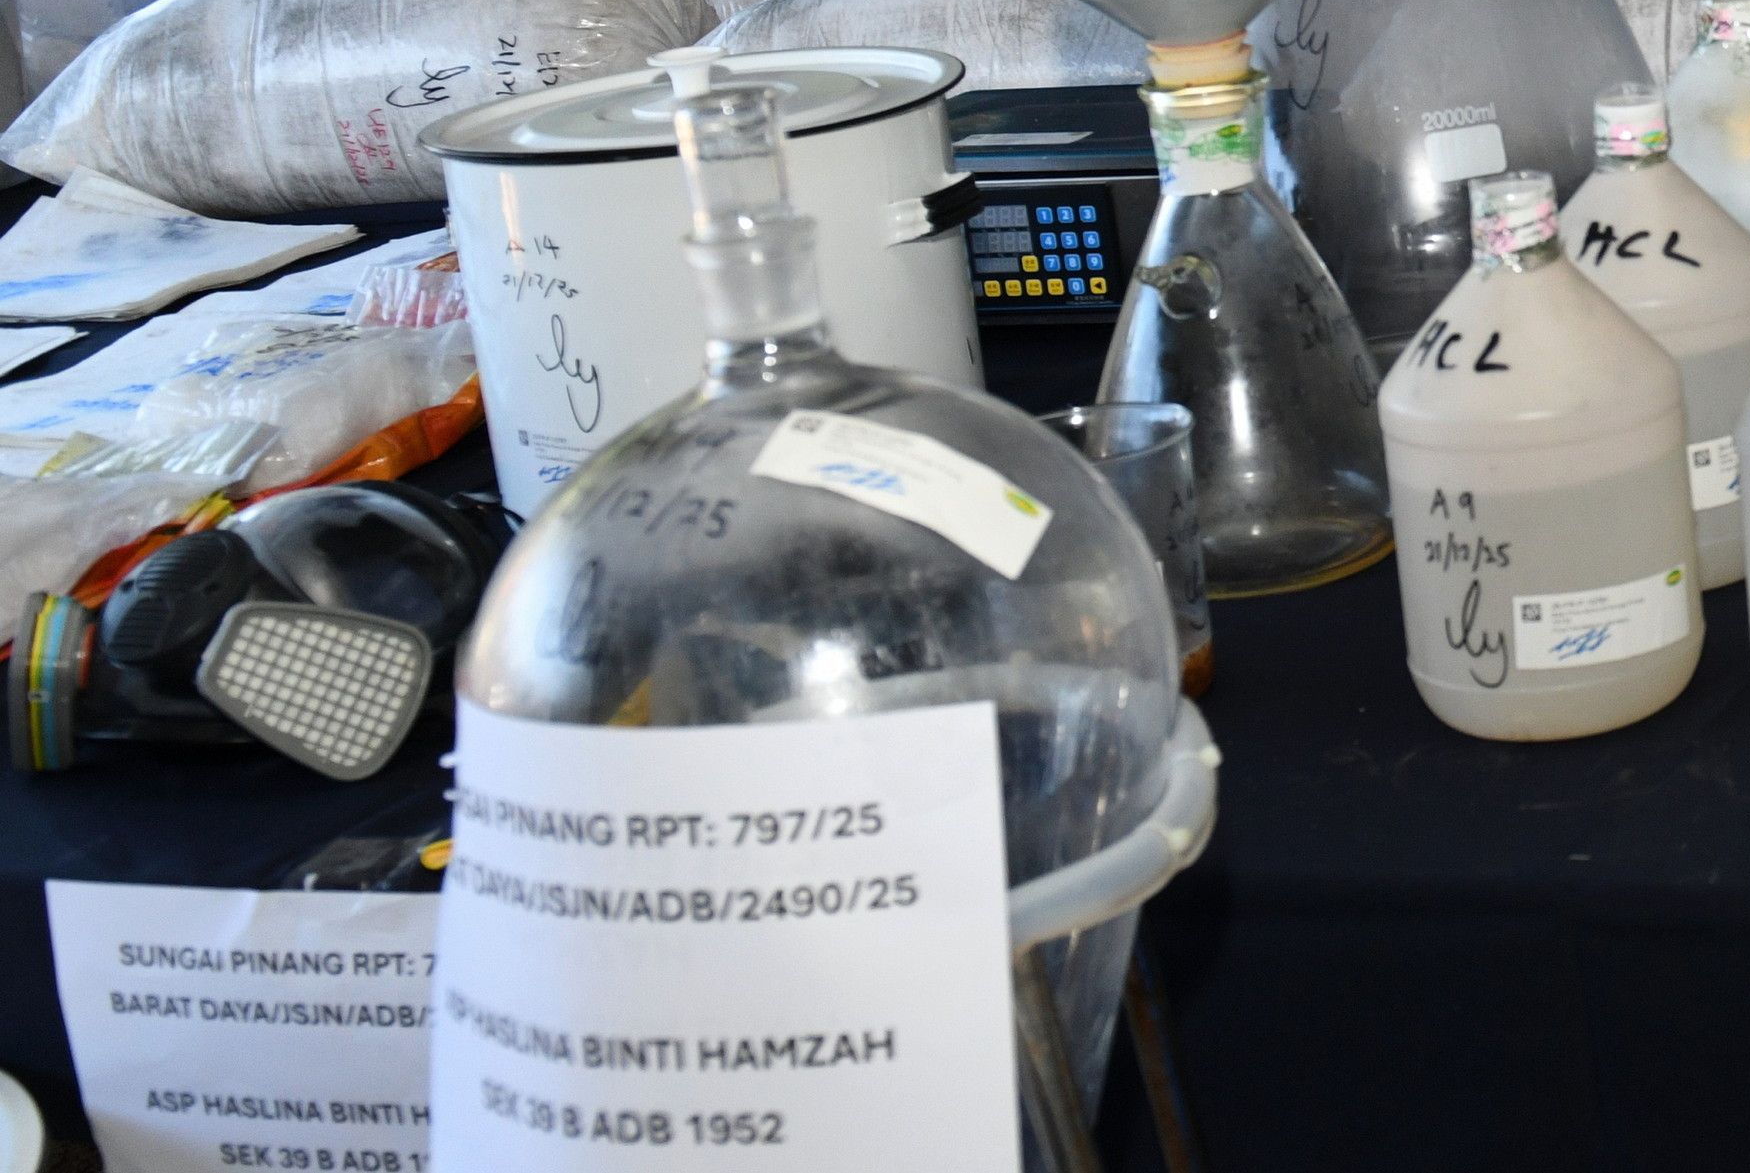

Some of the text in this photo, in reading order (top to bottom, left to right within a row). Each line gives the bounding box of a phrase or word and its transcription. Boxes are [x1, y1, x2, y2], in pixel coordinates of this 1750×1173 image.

[1421, 102, 1495, 130] 20000ml
[1041, 210, 1048, 220] 1
[1062, 210, 1071, 220] 2
[1084, 209, 1092, 219] 3
[1045, 235, 1096, 246] 4 5 6
[1578, 221, 1702, 268] HCL
[1047, 258, 1056, 268] 7
[1090, 257, 1099, 267] 9
[1072, 282, 1080, 291] 0
[1408, 320, 1511, 372] HCL
[627, 813, 718, 849] RPT:
[730, 801, 885, 847] 797/25
[118, 942, 224, 973] SUNGAI
[230, 949, 345, 977] PINANG
[352, 951, 415, 977] RPT:
[110, 991, 434, 1028] BARAT DAYA/JSJN/ADB/
[581, 1035, 687, 1073] BINTI
[699, 1026, 897, 1071] HAMZAH
[146, 1090, 196, 1113] ASP
[202, 1094, 323, 1123] HASLINA
[330, 1101, 404, 1126] BINTI
[591, 1110, 677, 1146] ADB
[688, 1110, 787, 1146] 1952
[220, 1142, 273, 1168] SEK
[278, 1147, 309, 1170] 39
[316, 1149, 336, 1171] B
[342, 1150, 402, 1173] ADB
